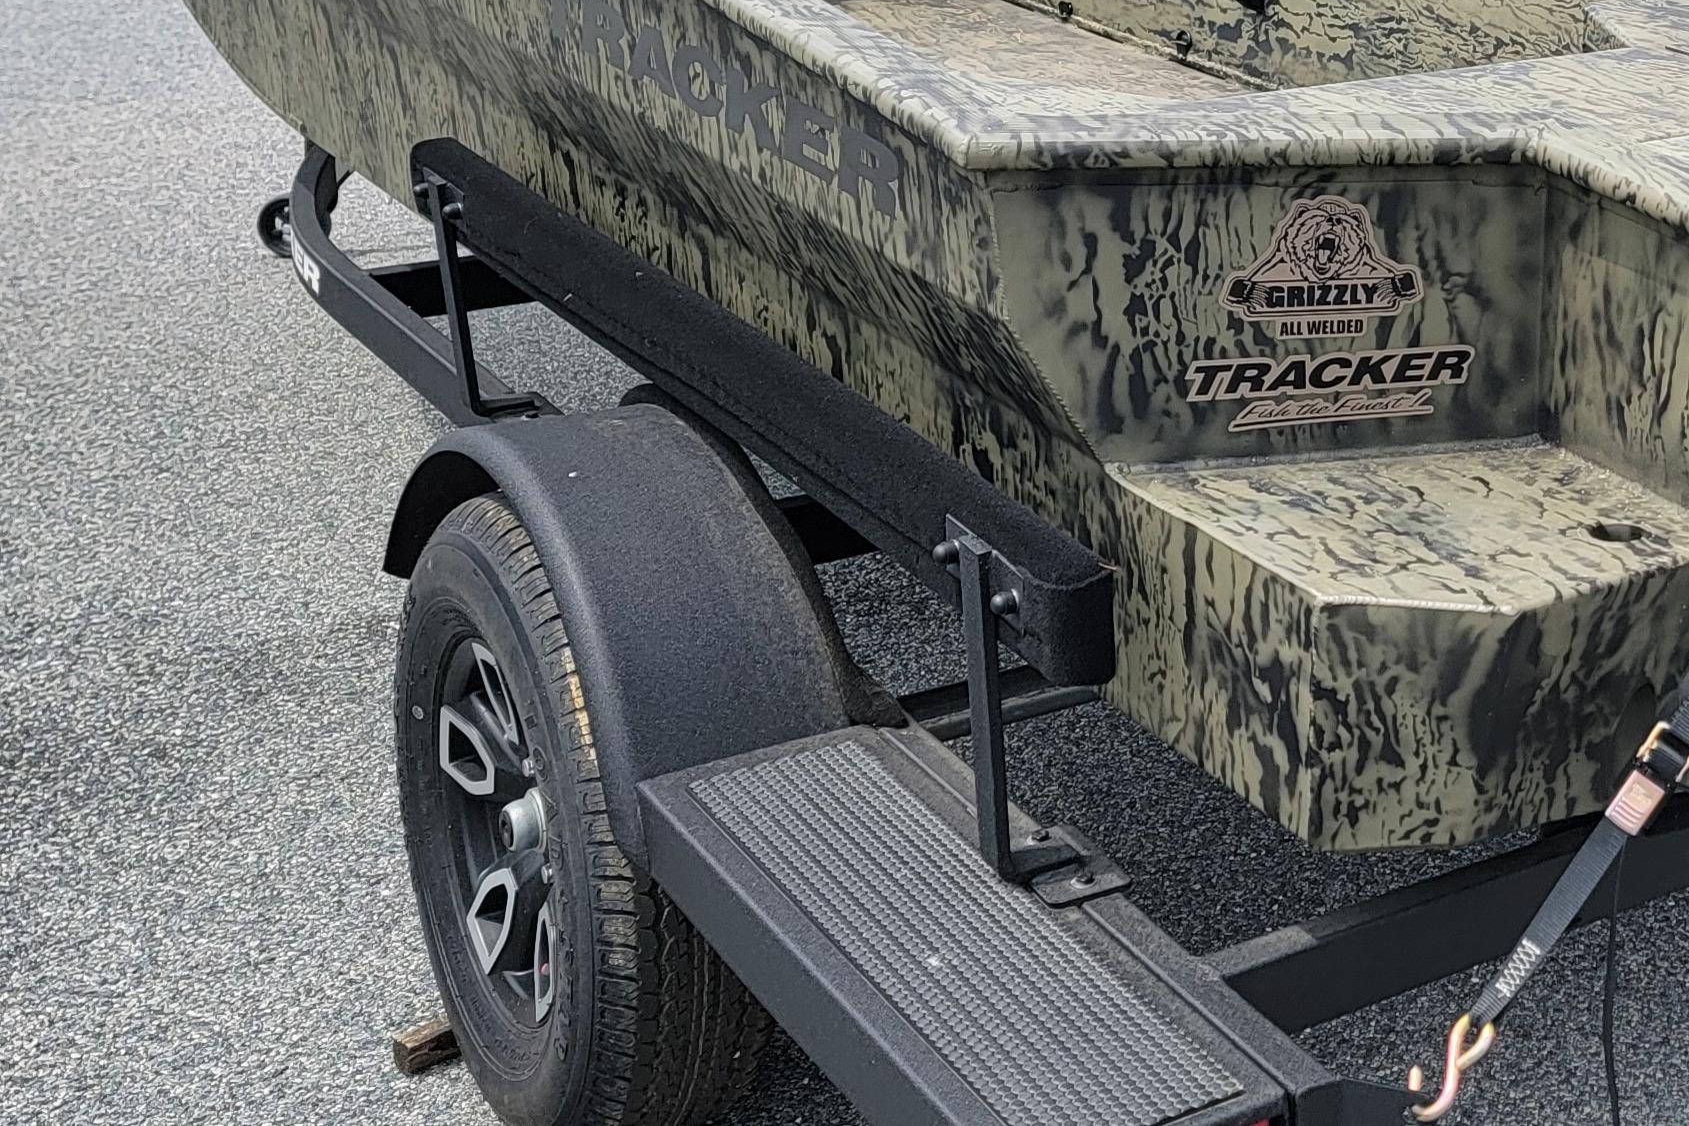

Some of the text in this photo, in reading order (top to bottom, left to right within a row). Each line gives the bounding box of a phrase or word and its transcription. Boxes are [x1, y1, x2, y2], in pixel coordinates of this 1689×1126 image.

[1267, 283, 1377, 308] GRIZZLY
[1280, 319, 1363, 336] ALL WELDED
[1193, 349, 1472, 397] TRACKER
[1240, 404, 1292, 420] Fish
[1295, 402, 1331, 416] the
